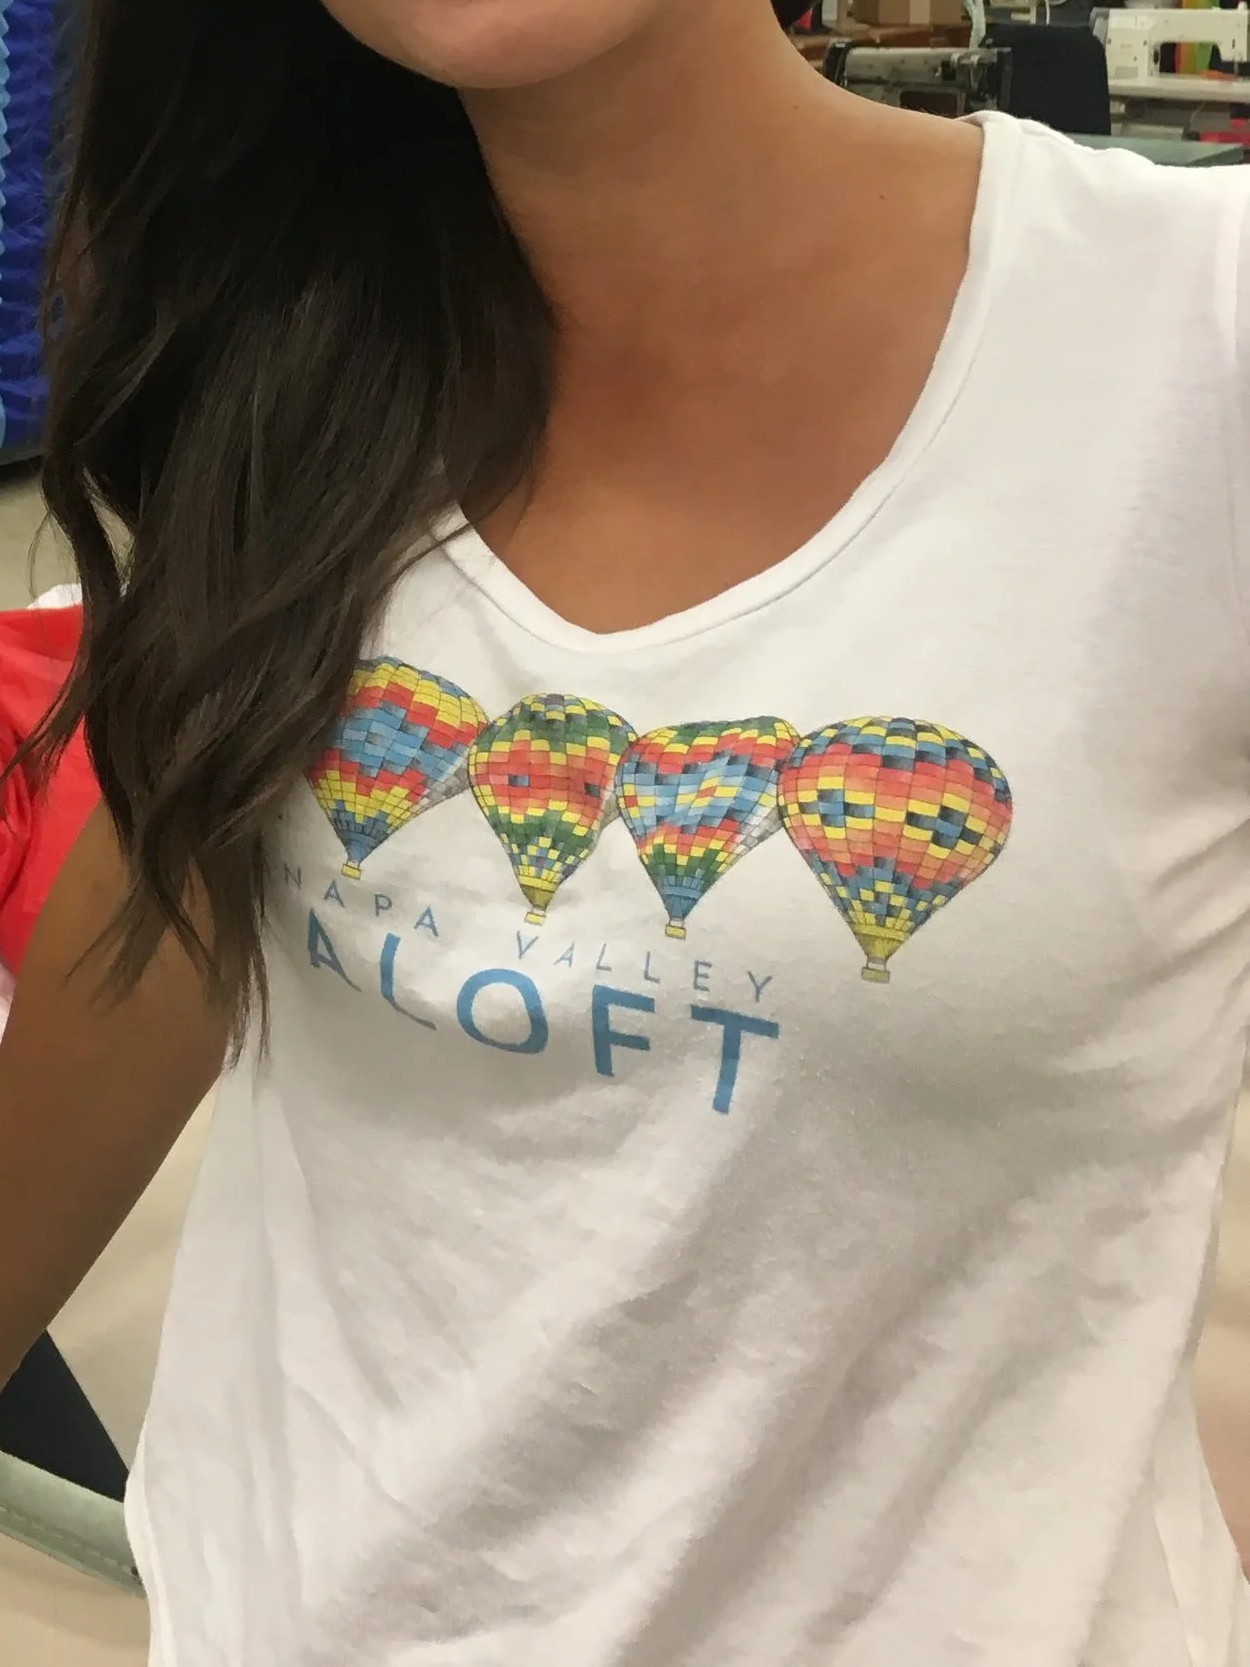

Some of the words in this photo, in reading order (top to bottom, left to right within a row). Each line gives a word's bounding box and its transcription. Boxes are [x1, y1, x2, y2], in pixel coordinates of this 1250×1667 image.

[283, 861, 440, 938] NAPA
[516, 930, 773, 1002] VALLEY
[306, 908, 780, 1115] ALOFT
